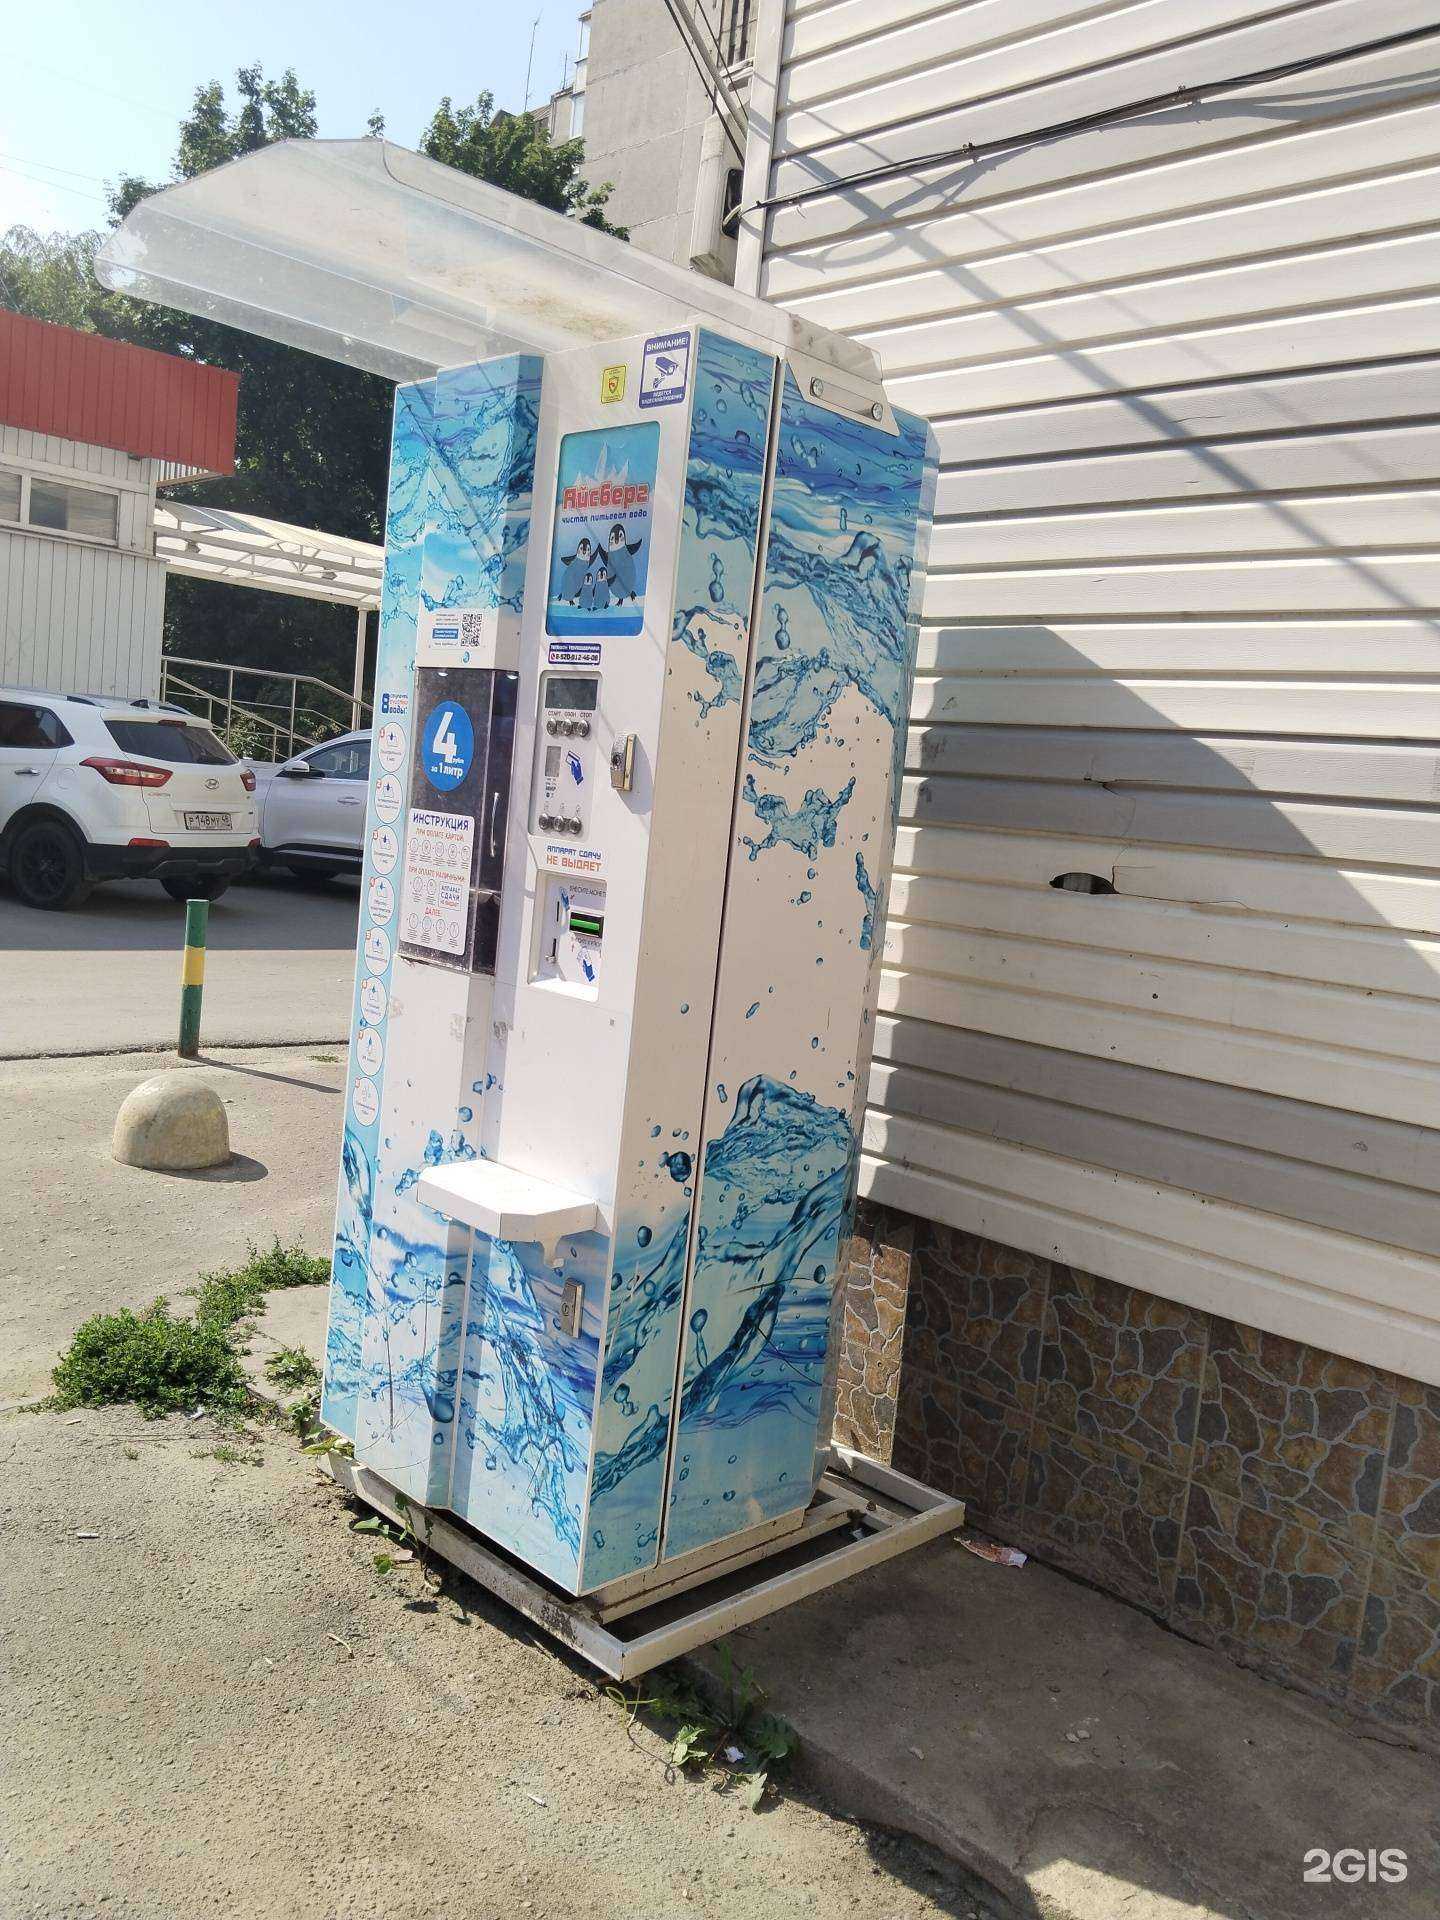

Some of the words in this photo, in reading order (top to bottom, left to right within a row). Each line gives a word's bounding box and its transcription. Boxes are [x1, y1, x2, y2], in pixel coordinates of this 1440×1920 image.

[646, 337, 688, 351] ВНИМАНИЕ!
[629, 508, 648, 519] вода
[433, 711, 458, 763] 4
[413, 812, 469, 832] ИНСТРУКЦИЯ
[547, 845, 577, 856] АППАРАТ
[579, 850, 601, 860] СДАЧУ
[546, 854, 558, 866] НЕ
[562, 857, 602, 872] ВЫДАЕТ
